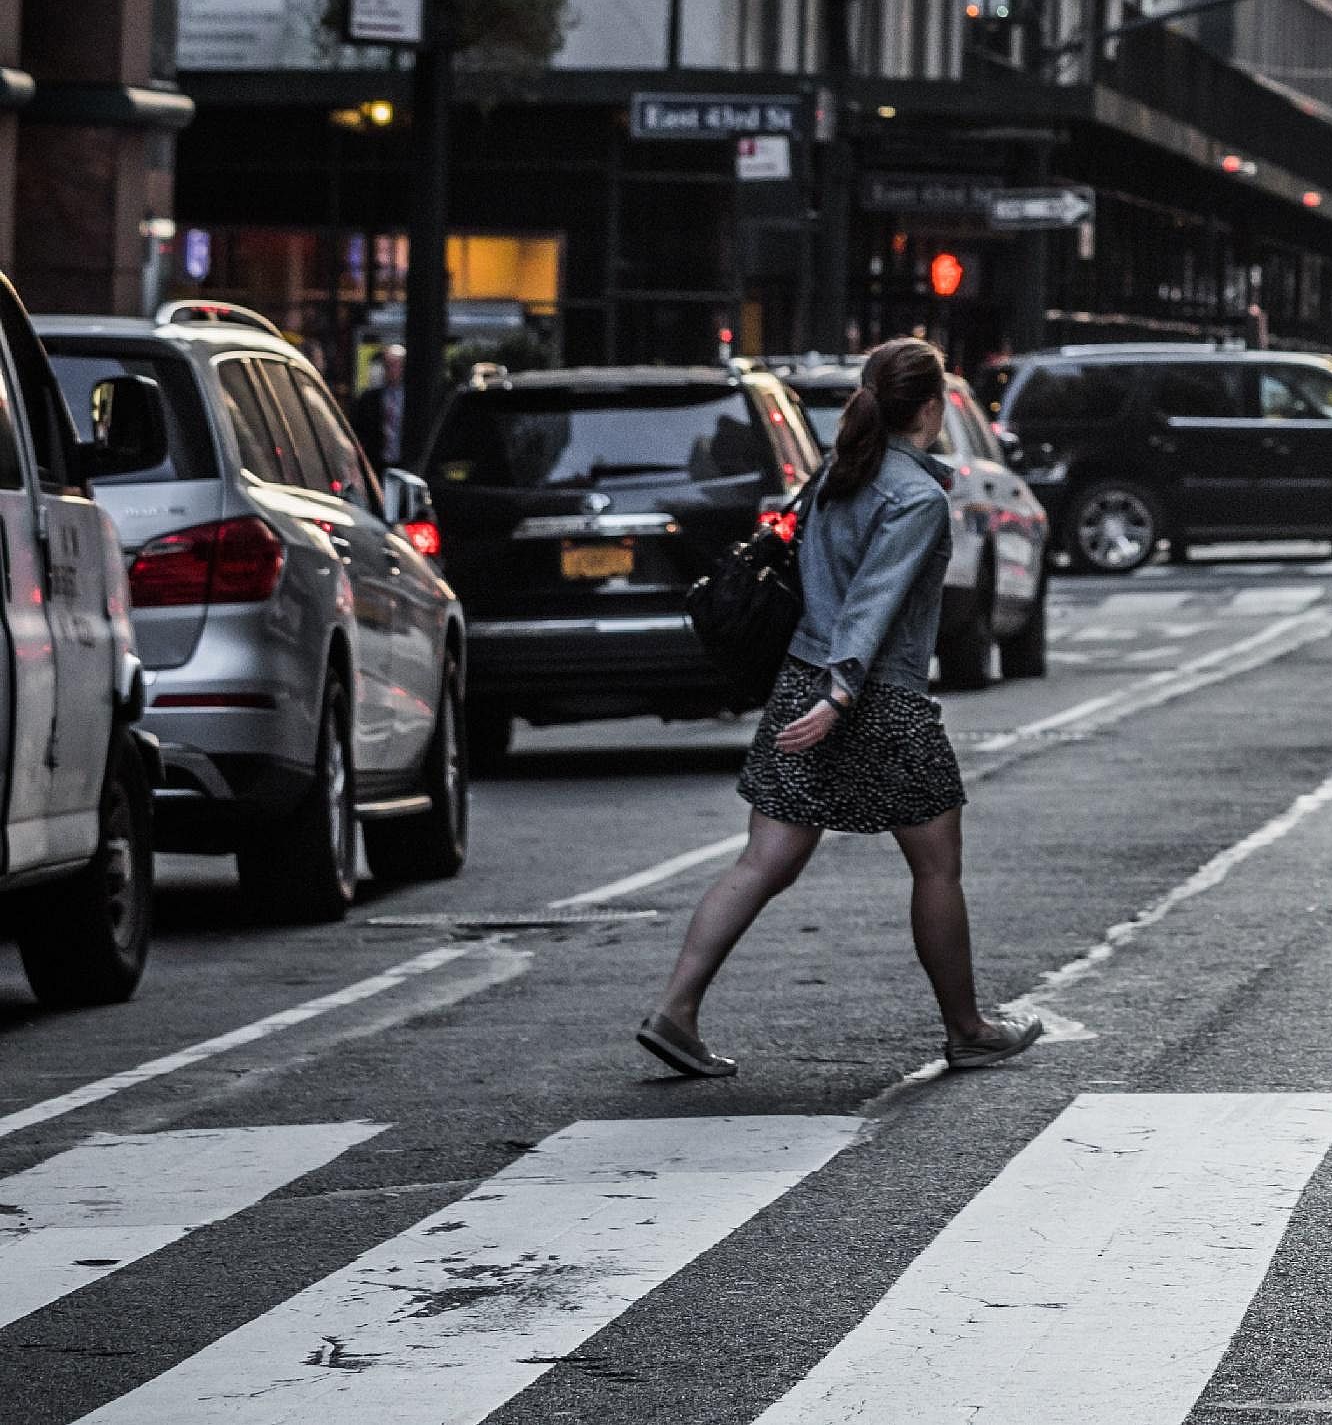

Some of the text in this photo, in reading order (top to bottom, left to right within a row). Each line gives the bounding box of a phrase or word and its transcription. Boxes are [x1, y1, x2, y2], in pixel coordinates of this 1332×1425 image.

[645, 104, 793, 129] East 43rd St
